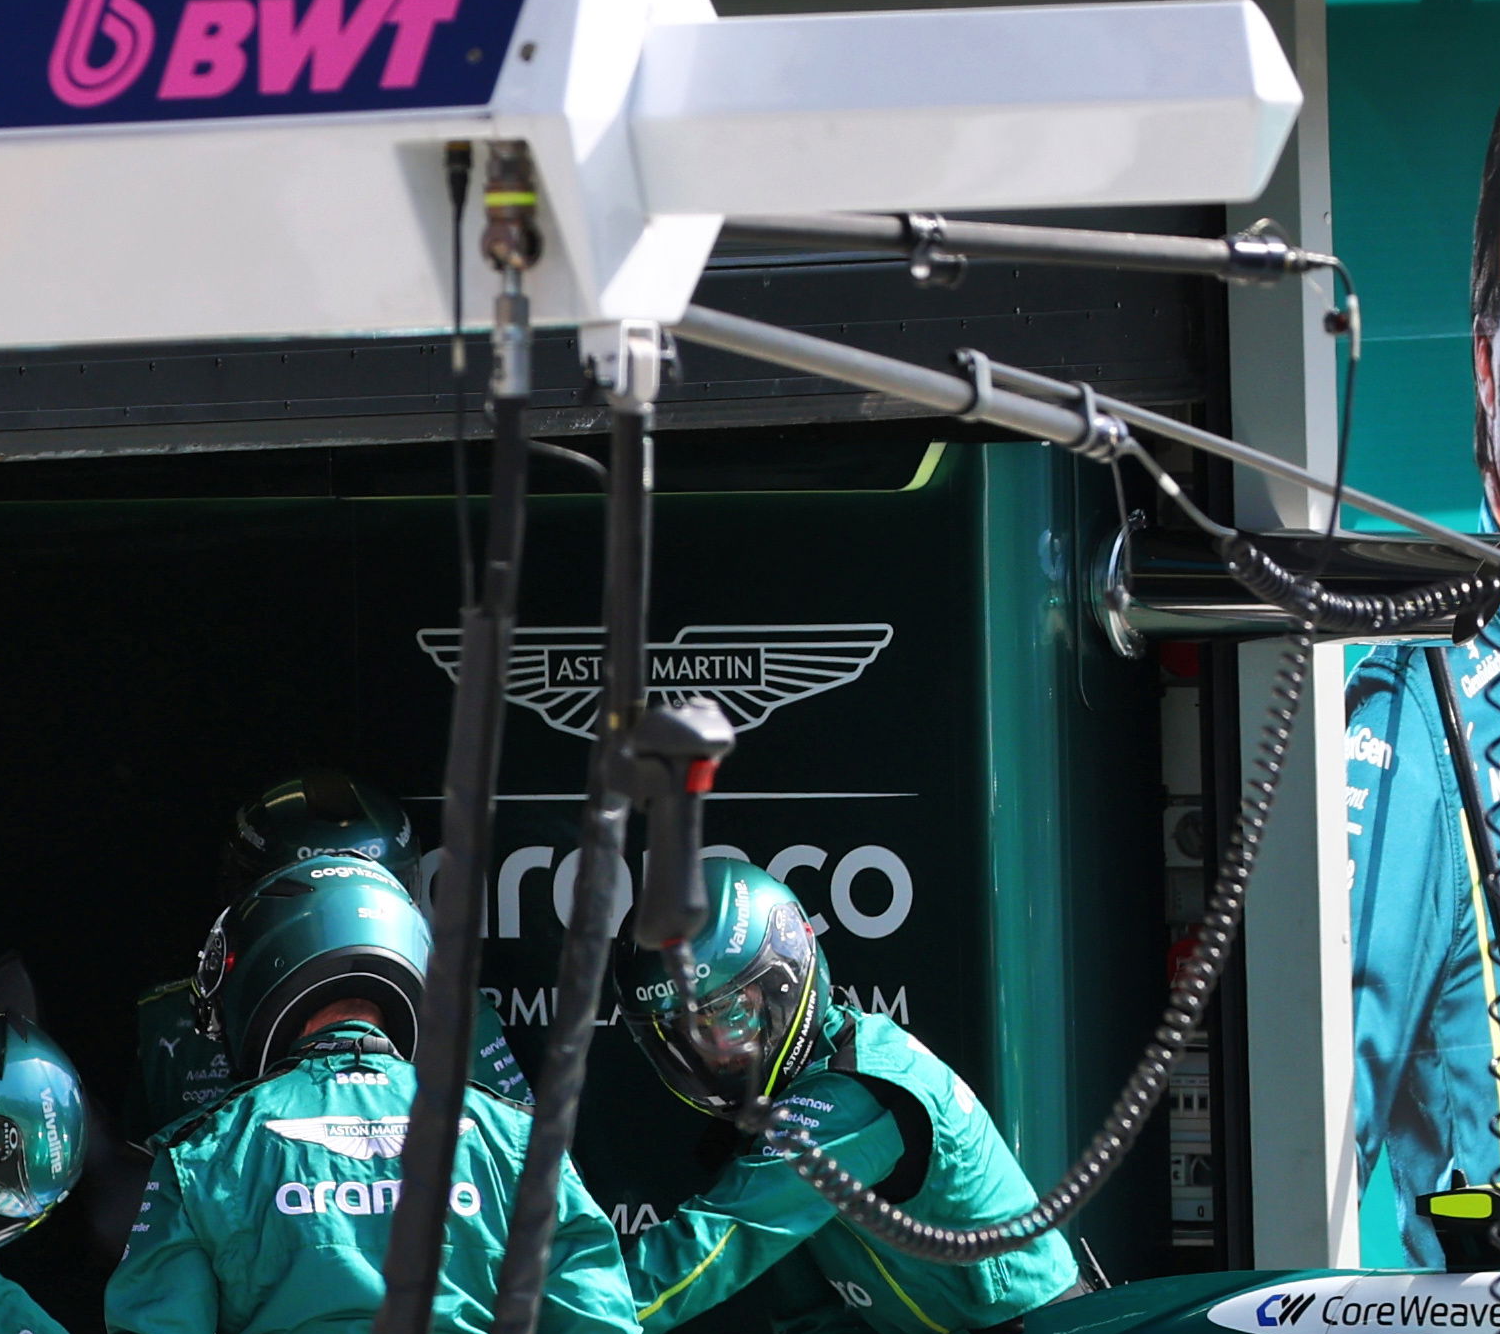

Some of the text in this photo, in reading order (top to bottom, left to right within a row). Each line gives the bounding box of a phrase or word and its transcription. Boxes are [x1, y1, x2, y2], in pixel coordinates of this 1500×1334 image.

[556, 653, 755, 681] AST MARTIN
[782, 1034, 805, 1077] ASTON
[798, 989, 818, 1037] MARTIN
[329, 1123, 409, 1137] ASTON MART
